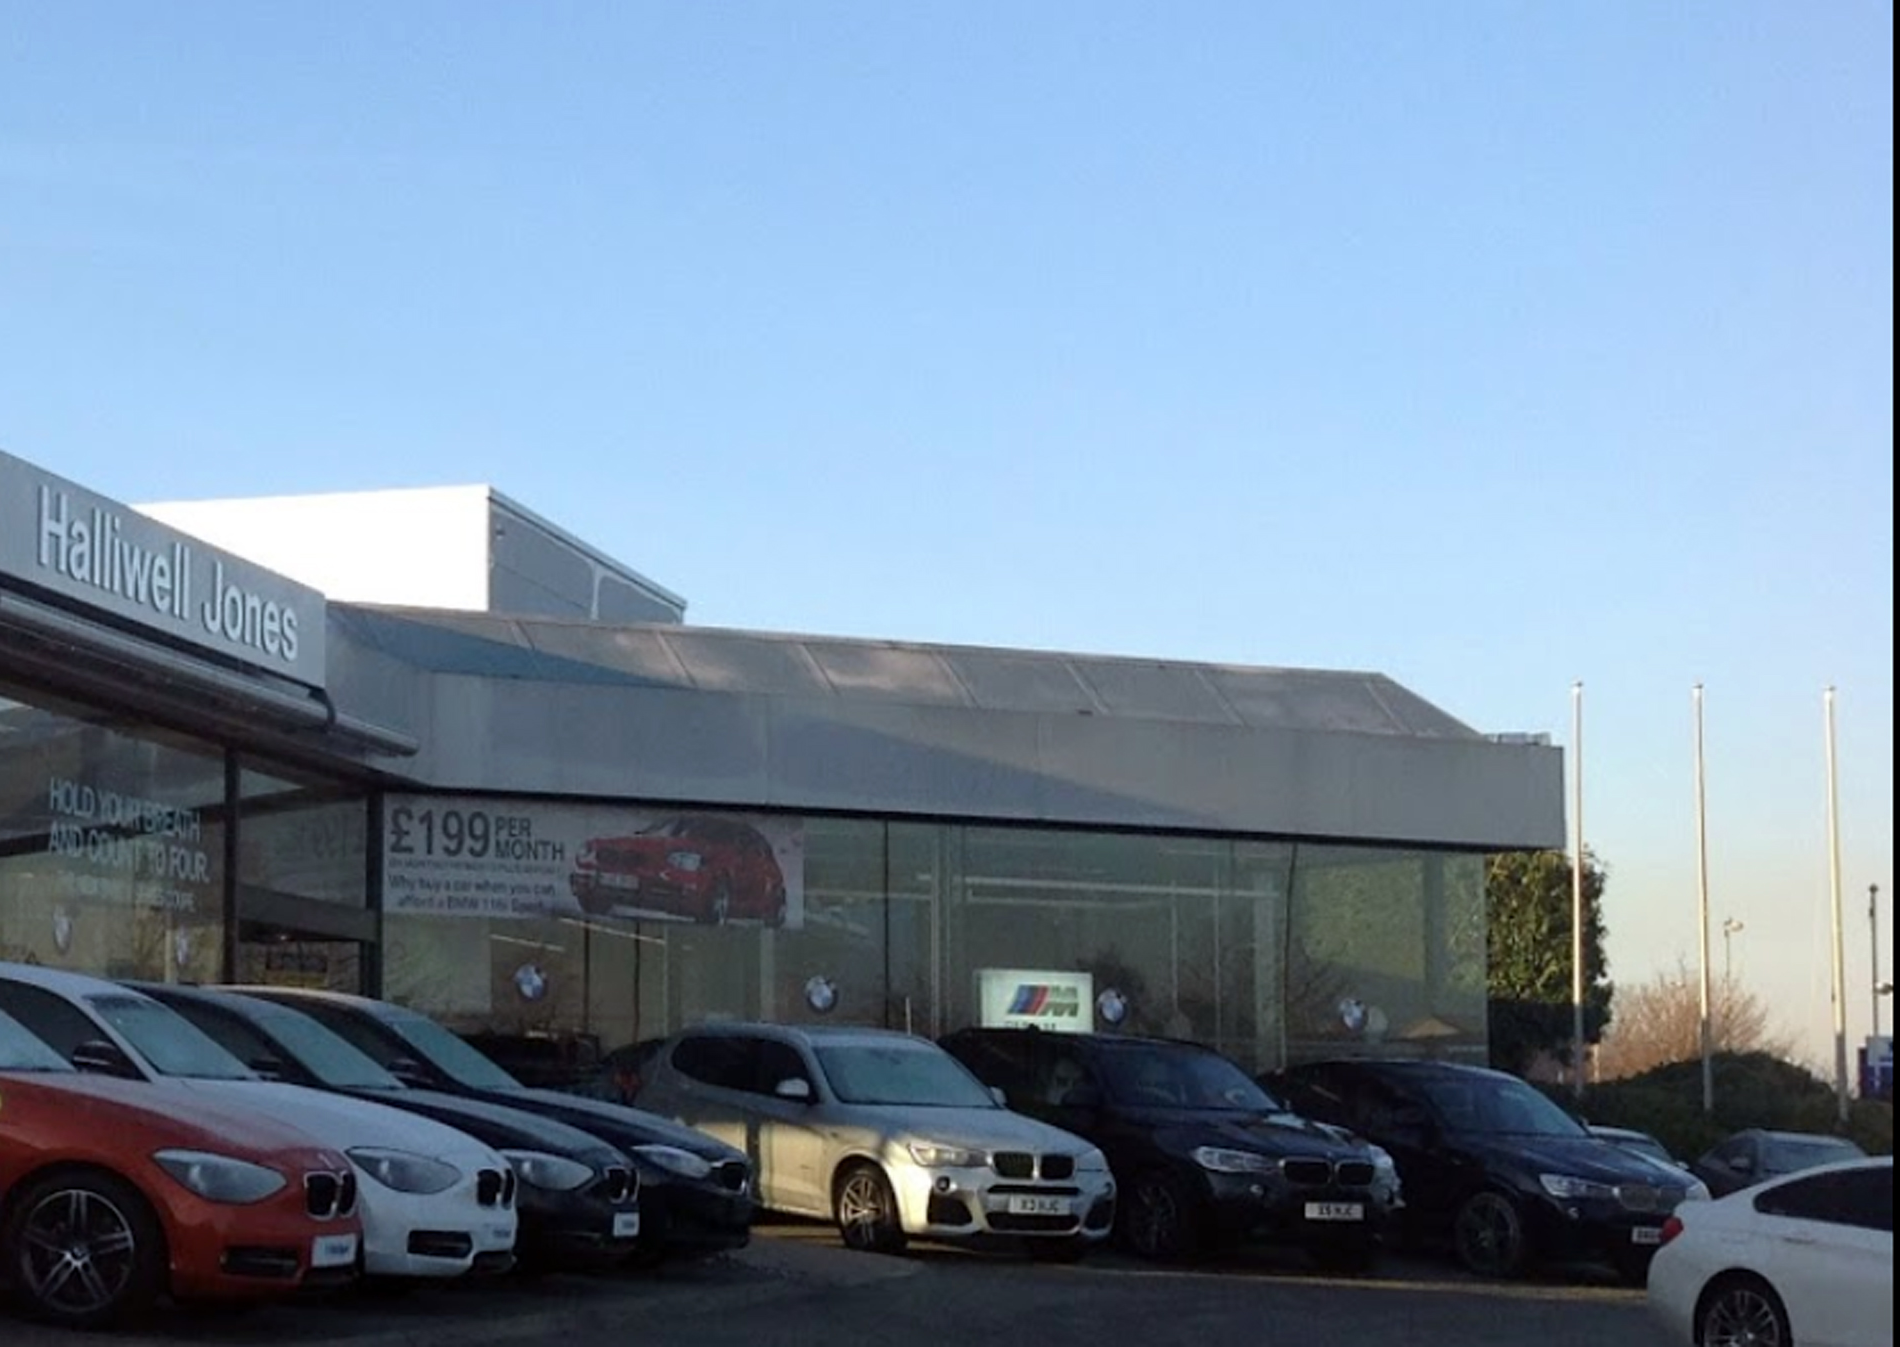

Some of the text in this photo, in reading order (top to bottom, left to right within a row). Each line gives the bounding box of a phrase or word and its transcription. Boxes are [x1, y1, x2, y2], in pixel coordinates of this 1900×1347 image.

[38, 484, 298, 662] Halliwell Jones
[50, 777, 202, 844] HOLD YOUR BREATH
[390, 806, 532, 858] £199 PER
[49, 820, 84, 858] AND
[87, 829, 143, 872] COUNT
[145, 839, 166, 876] TO
[494, 838, 565, 861] MONTH
